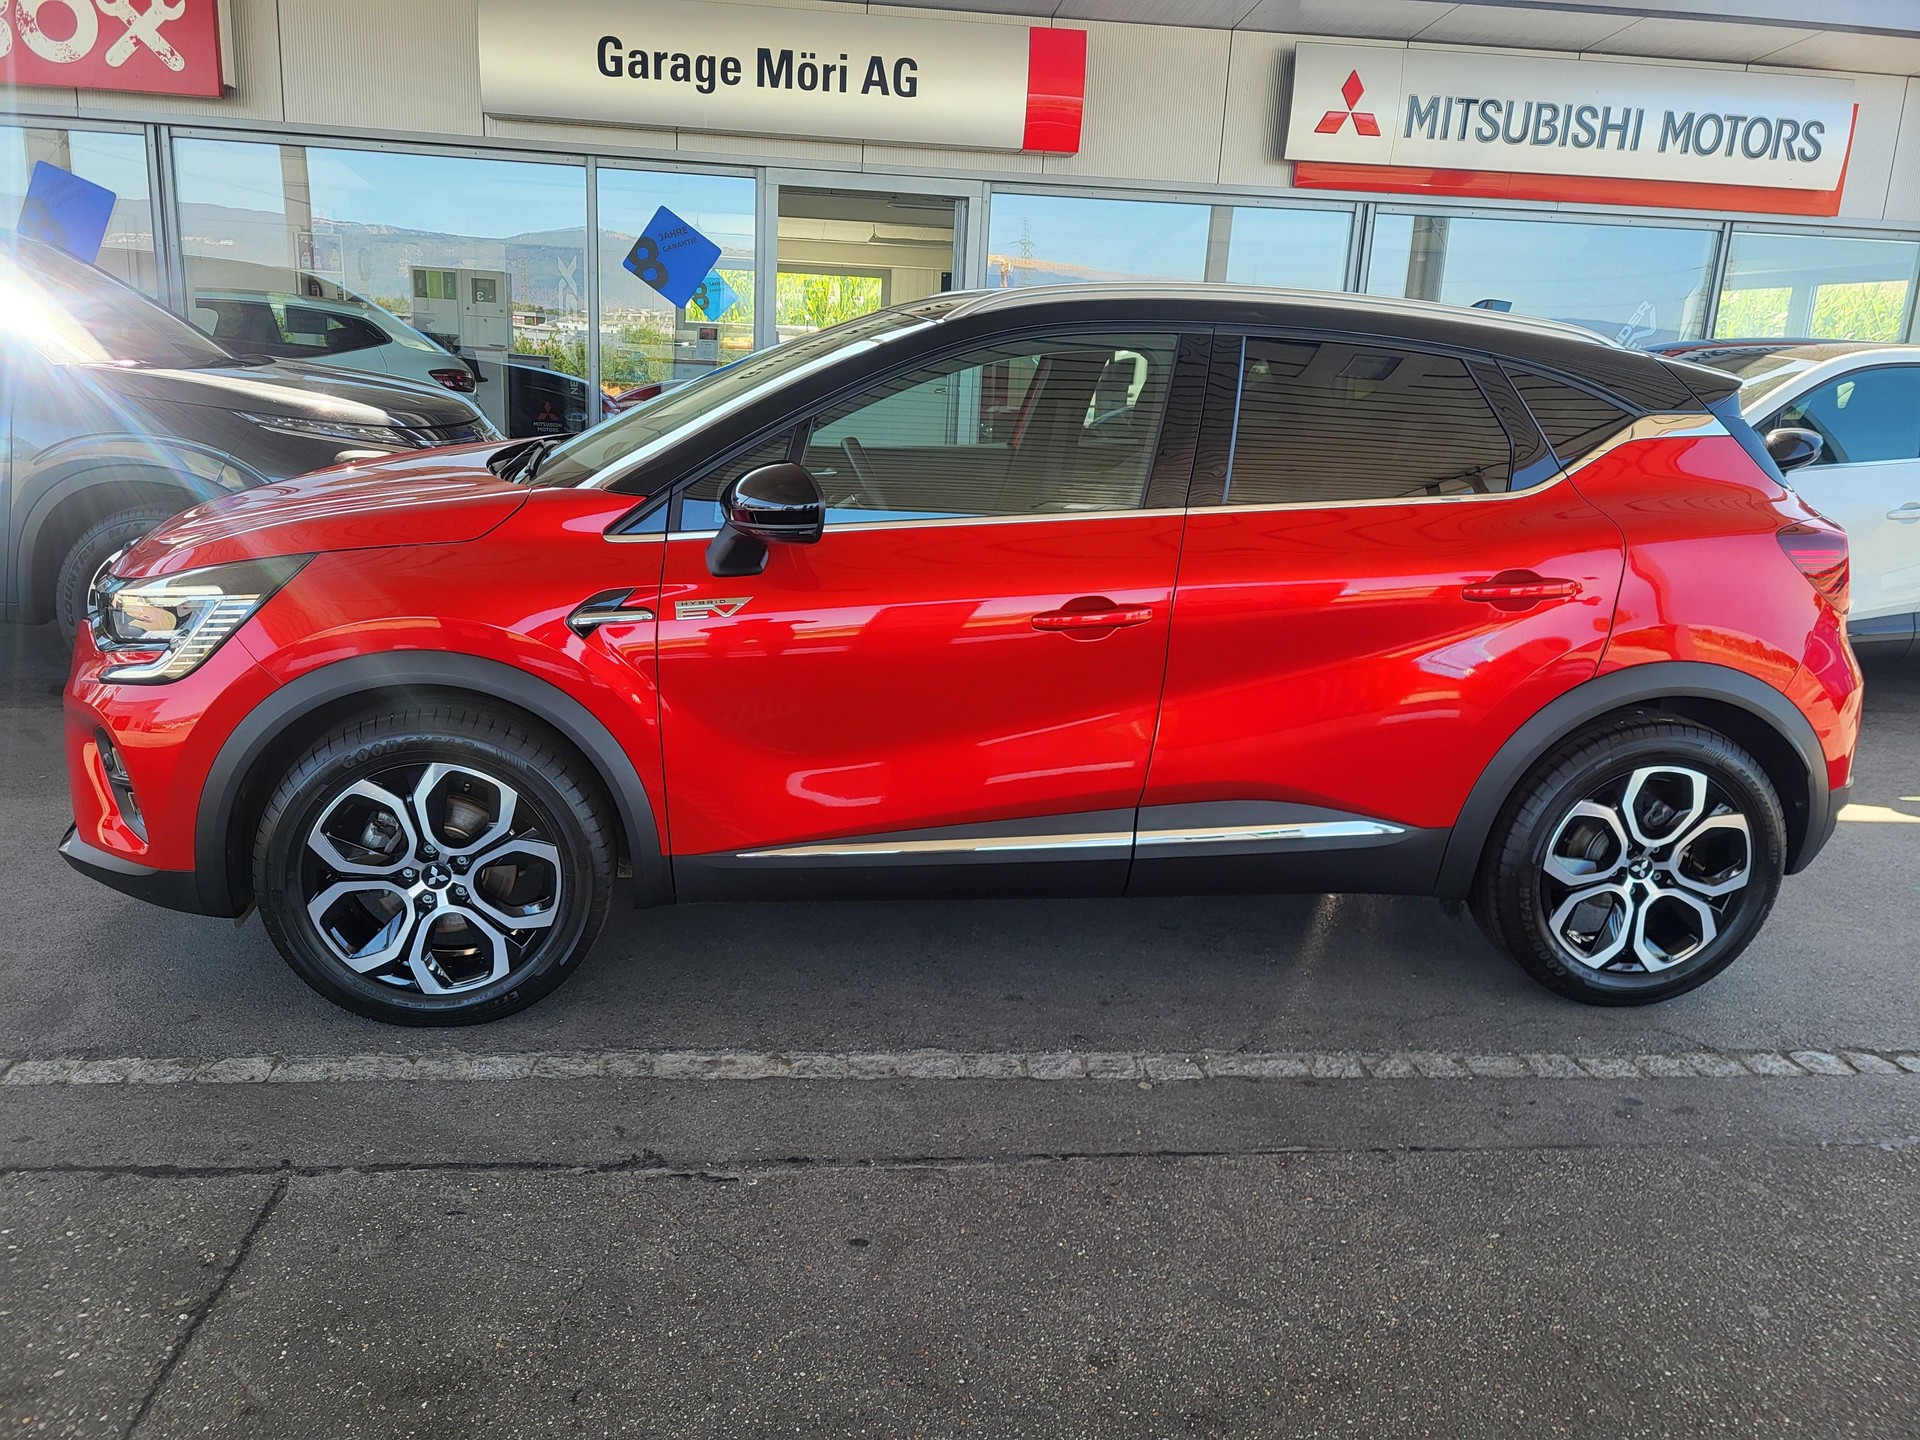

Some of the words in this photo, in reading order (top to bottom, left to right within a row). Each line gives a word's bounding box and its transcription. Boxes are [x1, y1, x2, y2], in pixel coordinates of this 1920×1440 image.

[0, 0, 186, 72] OX
[597, 36, 742, 94] Garage
[756, 47, 848, 93] Möri
[861, 55, 918, 98] AG
[1403, 94, 1645, 152] MITSUBISHI
[1658, 110, 1826, 163] MOTORS
[658, 226, 689, 242] JAHRE
[662, 236, 698, 253] GARANTIE
[627, 237, 669, 291] 8
[692, 283, 710, 310] 8
[64, 541, 96, 627] COUNTRY
